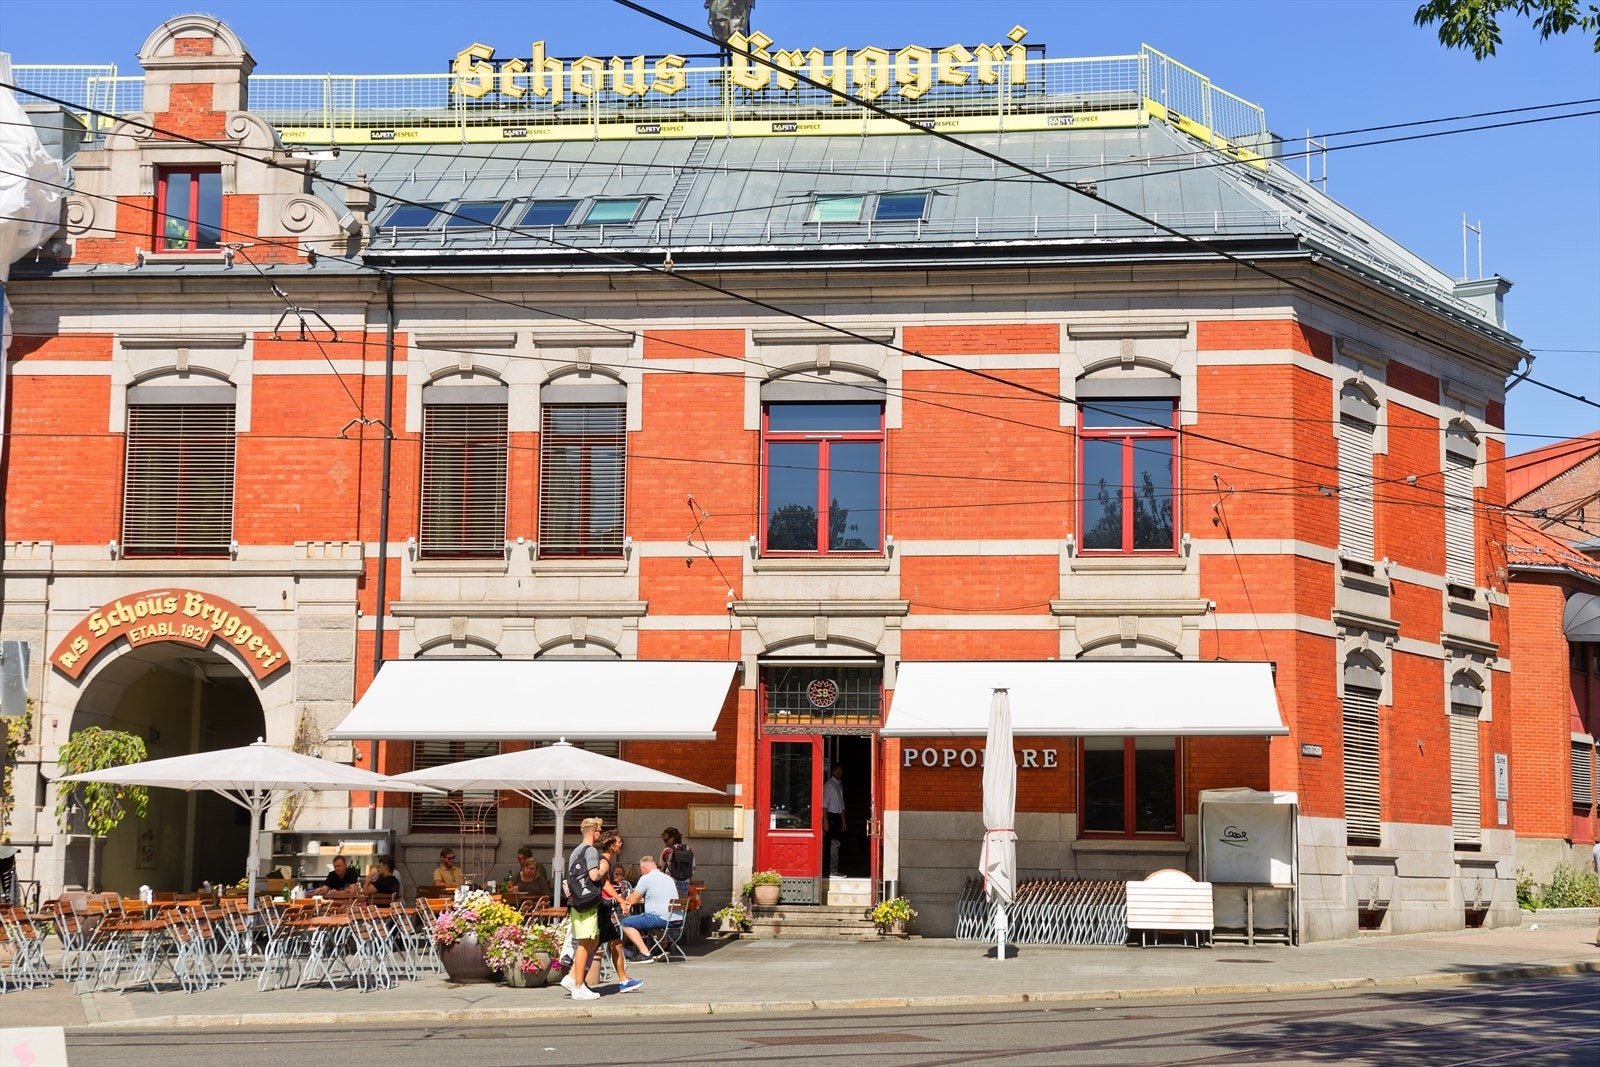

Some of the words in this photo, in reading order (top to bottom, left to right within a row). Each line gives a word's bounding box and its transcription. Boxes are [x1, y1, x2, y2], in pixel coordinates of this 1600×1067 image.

[450, 41, 687, 105] Schous
[727, 25, 1028, 103] Bryggeri
[88, 596, 178, 638] Schous
[182, 591, 283, 669] Bryggeri
[816, 688, 829, 698] SB
[903, 748, 1058, 768] POPORE
